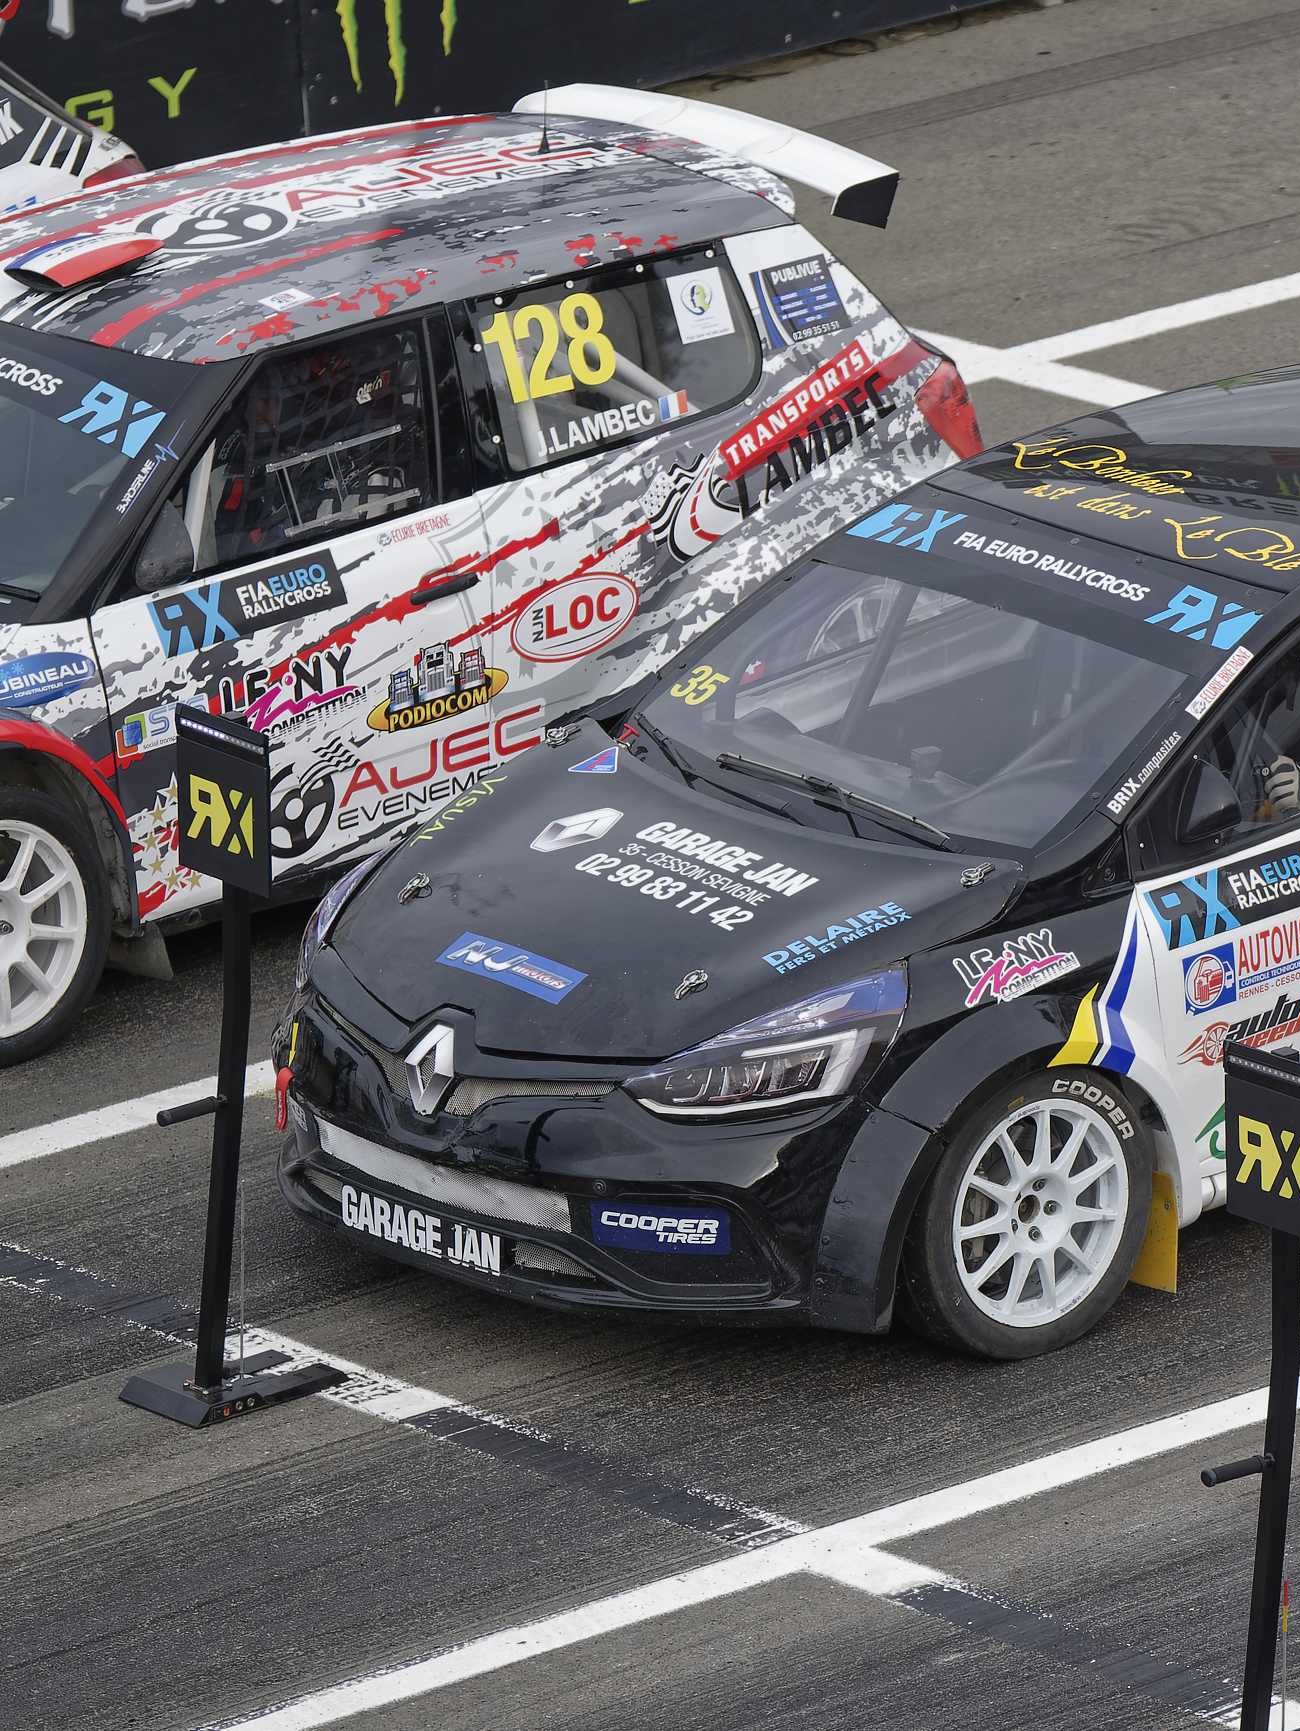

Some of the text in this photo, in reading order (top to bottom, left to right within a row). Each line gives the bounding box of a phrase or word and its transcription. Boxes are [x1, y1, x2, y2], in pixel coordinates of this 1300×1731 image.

[286, 140, 594, 212] AJEC
[770, 260, 822, 285] PUBLIVUE
[481, 292, 617, 403] 128
[535, 400, 656, 457] J.LAMBEC
[724, 346, 866, 466] TRANSPORTS
[1076, 493, 1152, 520] dans
[953, 531, 987, 551] FIA
[983, 539, 1040, 565] EURO
[1034, 554, 1151, 602] RALLYCROSS
[241, 581, 332, 619] RALLYCROSS
[545, 587, 621, 640] LOC
[389, 683, 488, 732] PODIOCOM
[670, 665, 731, 706] 35
[339, 704, 543, 808] AJEC
[187, 773, 254, 860] RX
[410, 775, 508, 848] VISUAL
[1106, 777, 1142, 815] BRIX
[636, 821, 820, 897] GARAGE JAN
[645, 852, 710, 881] CESSON
[702, 873, 772, 907] SEVIGNE
[574, 853, 754, 932] 02 99 83 11 42
[446, 940, 529, 971] NJ
[761, 900, 904, 967] DELAIRE
[775, 952, 817, 975] FERS
[818, 940, 838, 954] ET
[1001, 953, 1077, 998] COMPETITION
[1239, 983, 1270, 1000] RENNES
[1241, 971, 1271, 987] CONTROLE
[1052, 1079, 1135, 1141] COOPER
[341, 1184, 501, 1277] GARAGE JAN
[600, 1210, 720, 1234] COOPER
[655, 1230, 717, 1245] TIRES
